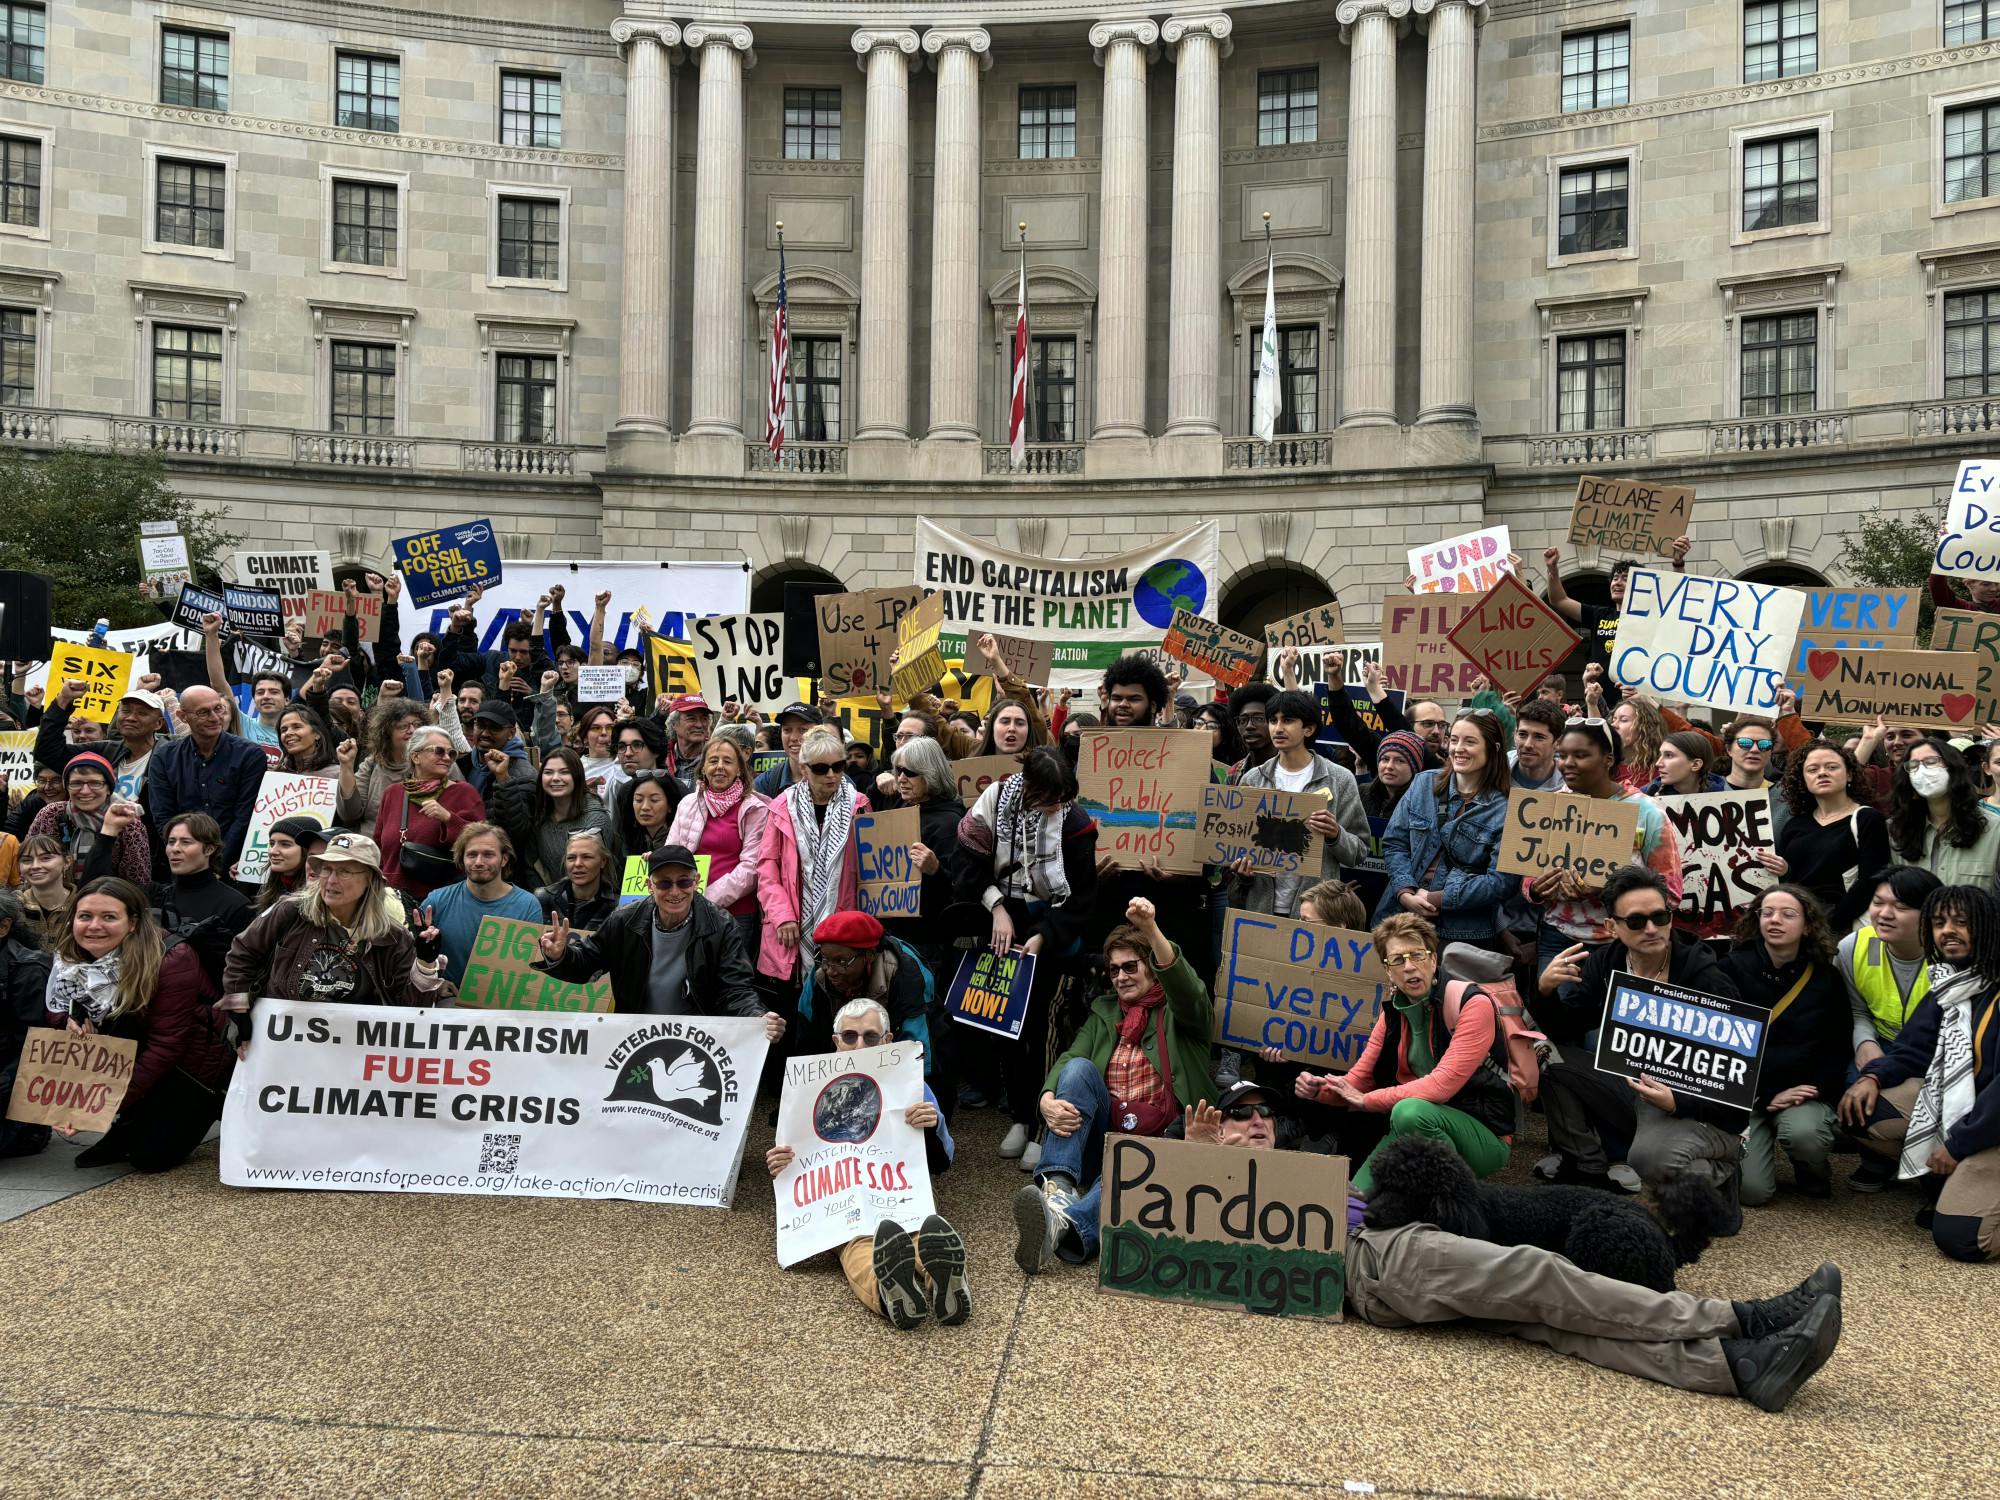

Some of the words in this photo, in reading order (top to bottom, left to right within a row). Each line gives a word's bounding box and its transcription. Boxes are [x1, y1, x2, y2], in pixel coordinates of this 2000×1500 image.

[1959, 466, 2000, 492] Ev
[1580, 481, 1663, 512] DECLARE
[1671, 495, 1685, 516] A
[1576, 506, 1656, 533] CLIMATE
[407, 534, 441, 556] OFF
[1421, 536, 1498, 577] FUND
[1571, 526, 1681, 558] EMERGENC
[1936, 534, 2000, 572] Cou
[247, 556, 320, 574] CLIMATE
[402, 547, 468, 575] FOSSIL
[431, 560, 488, 587] FUELS
[926, 551, 974, 584] END
[982, 560, 1129, 597] CAPITALISM
[184, 591, 227, 615] PARD
[226, 591, 278, 609] PARDON
[283, 598, 306, 616] OW
[311, 593, 345, 613] FILL
[355, 595, 379, 616] THE
[431, 585, 468, 598] CLIMATE
[1626, 571, 1780, 631] EVERY
[228, 609, 280, 627] DONZIGER
[822, 603, 867, 634] Use
[900, 607, 923, 644] ONE
[992, 593, 1035, 626] THE
[1042, 598, 1132, 629] PLANET
[1177, 609, 1225, 637] PROTECT
[1229, 627, 1254, 648] OUR
[1480, 603, 1535, 633] LNG
[695, 616, 780, 660] STOP
[864, 635, 880, 655] 4
[938, 640, 953, 652] RTY
[956, 641, 966, 653] FO
[1184, 640, 1237, 671] FUTURE
[1417, 643, 1447, 653] THE
[1688, 624, 1773, 665] DAY
[63, 656, 119, 680] SIX
[1484, 648, 1553, 671] KILLS
[1841, 656, 1964, 690] NATIONAL
[716, 664, 783, 706] LNG
[1616, 646, 1784, 709] COUNTS
[72, 697, 111, 712] EFT
[1815, 689, 1945, 717] MONUMENTS
[1092, 735, 1172, 772] Protect
[254, 778, 330, 814] CLIMATE
[262, 791, 336, 826] JUSTICE
[1108, 777, 1174, 813] Public
[1204, 788, 1244, 810] END
[1255, 793, 1299, 817] ALL
[1203, 813, 1254, 838] Fossil
[1518, 797, 1618, 838] Confirm
[1666, 800, 1774, 848] MORE
[856, 817, 913, 882] Every
[1208, 842, 1298, 872] SUBSIDIES
[1516, 836, 1619, 877] Judges
[858, 891, 881, 916] Day
[880, 884, 921, 914] COUNTS
[1681, 849, 1768, 922] GAS
[475, 920, 541, 961] BIG
[1290, 927, 1373, 973] DAY
[969, 972, 987, 987] NEW
[976, 952, 1017, 979] GREN
[459, 964, 609, 1012] ENERGY
[960, 987, 1009, 1022] NOW!
[1654, 985, 1700, 1001] President
[1700, 996, 1731, 1011] Biden:
[267, 1014, 341, 1043] U.S.
[356, 1021, 589, 1055] MILITARISM
[1617, 991, 1756, 1050] PARDON
[29, 1039, 96, 1070] EVERY
[1262, 1016, 1369, 1063] COUNT
[1611, 1027, 1748, 1085] DONZIGER
[363, 1054, 491, 1086] FUELS
[604, 1022, 682, 1072] VETERANS
[685, 1027, 716, 1052] FOR
[712, 1049, 738, 1103] PEACE
[785, 1056, 856, 1088] AMERICA
[877, 1049, 901, 1069] IS
[1625, 1058, 1643, 1069] Text
[1644, 1063, 1683, 1080] PARDON
[1684, 1073, 1694, 1082] to
[1695, 1077, 1725, 1091] 66866
[27, 1076, 112, 1113] COUNTS
[258, 1085, 437, 1119] CLIMATE
[451, 1094, 580, 1125] CRISIS
[601, 1105, 720, 1141] www.veteransforpeace.org
[799, 1145, 893, 1169] WATCHING...
[247, 1167, 725, 1198] www.veteransforpeace.org/take-action/climatecrisi
[793, 1157, 863, 1208] CLIMATE
[867, 1161, 913, 1191] S.O.S.
[1110, 1139, 1334, 1250] Pardon
[792, 1212, 812, 1229] DO
[824, 1195, 856, 1216] YOUR
[869, 1194, 898, 1207] JOB
[1110, 1231, 1340, 1314] Donziger
